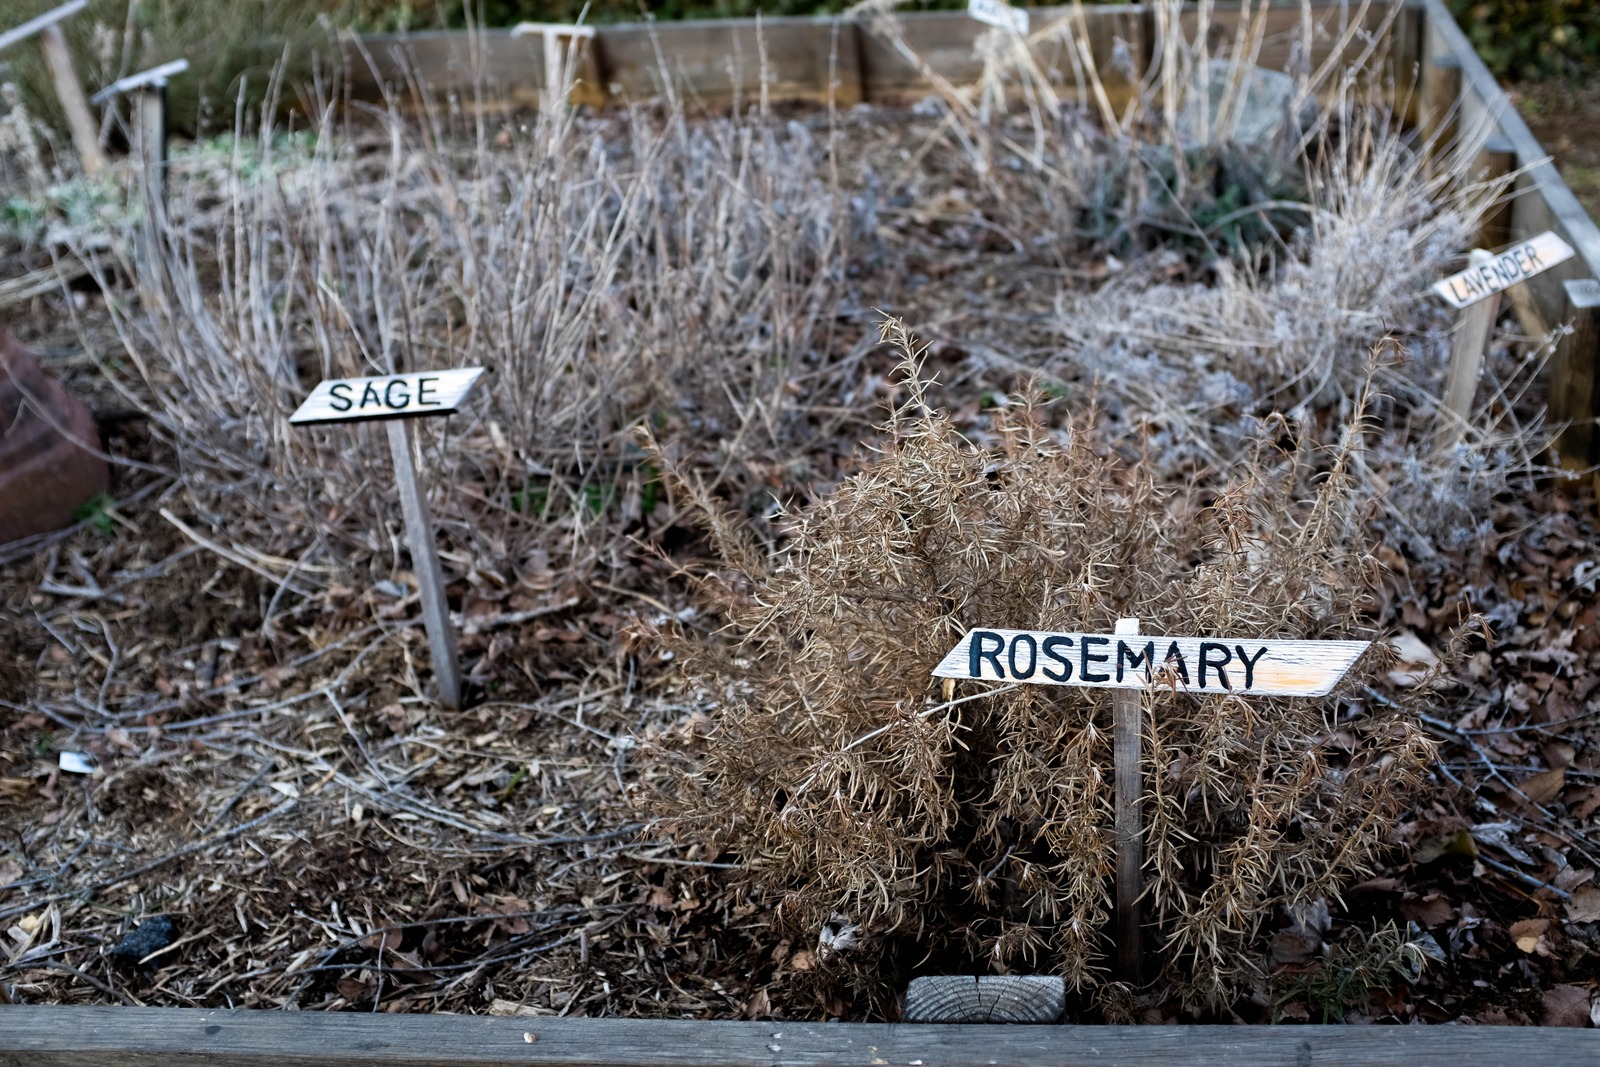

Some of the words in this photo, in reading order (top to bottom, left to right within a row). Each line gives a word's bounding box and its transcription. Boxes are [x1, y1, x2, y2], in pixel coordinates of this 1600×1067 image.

[1449, 245, 1544, 303] LAVENDER
[329, 377, 441, 412] SAGE
[968, 630, 1268, 691] ROSEMARY
